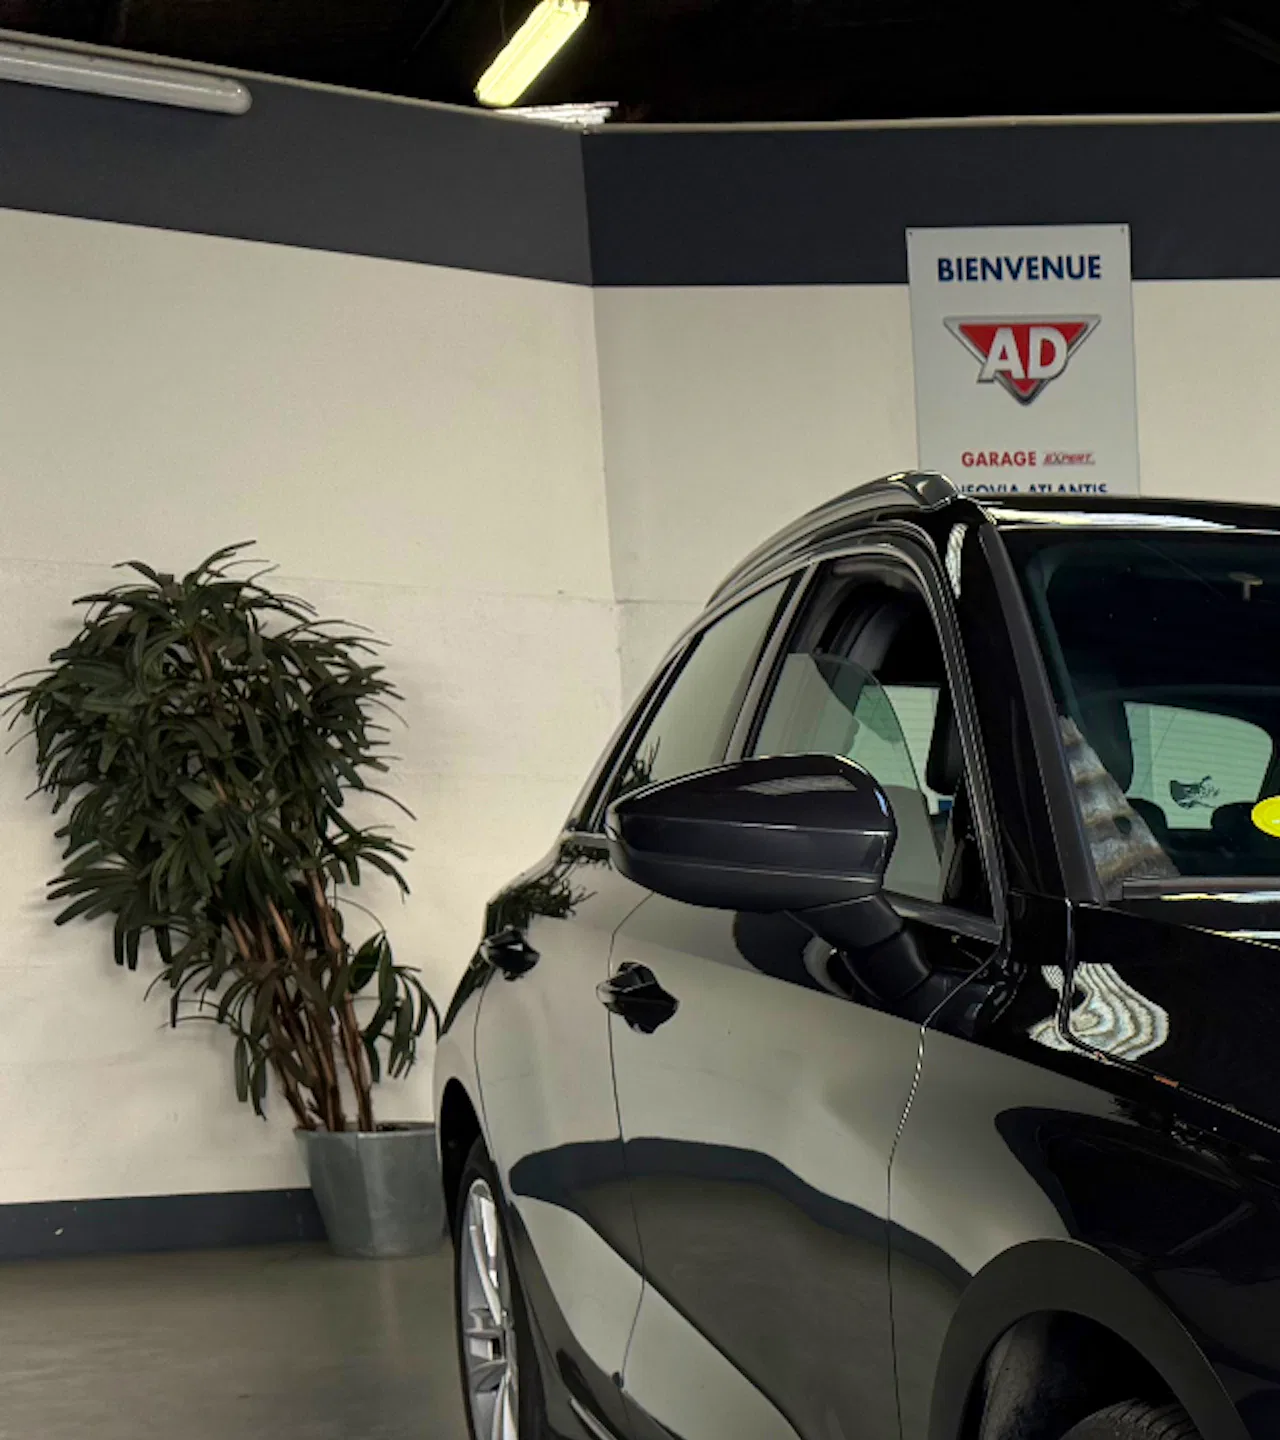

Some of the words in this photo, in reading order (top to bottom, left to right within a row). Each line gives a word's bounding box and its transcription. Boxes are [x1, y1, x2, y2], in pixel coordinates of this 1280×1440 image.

[937, 255, 1102, 282] BIENVENUE
[977, 326, 1068, 383] AD
[961, 451, 1037, 467] GARAGE
